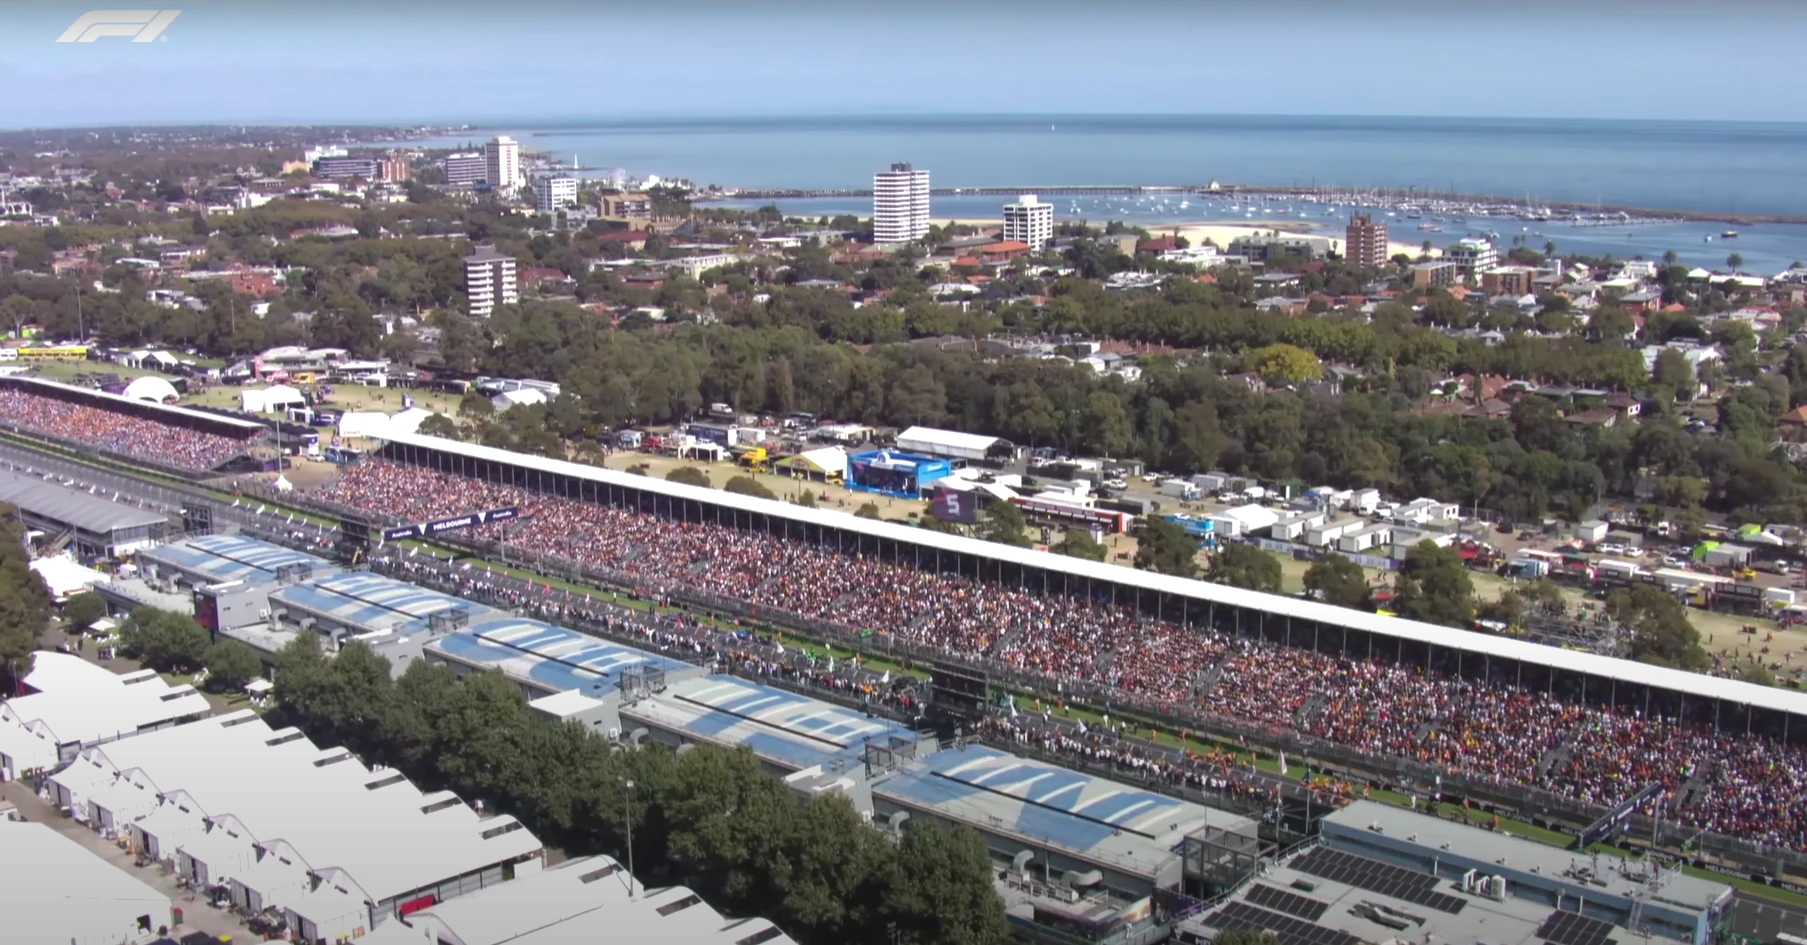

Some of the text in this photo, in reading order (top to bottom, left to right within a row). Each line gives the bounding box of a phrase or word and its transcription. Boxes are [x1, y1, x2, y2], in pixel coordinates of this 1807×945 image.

[946, 494, 960, 514] 5
[433, 517, 472, 531] MELBOURNE
[1704, 863, 1752, 881] MELBOURNE
